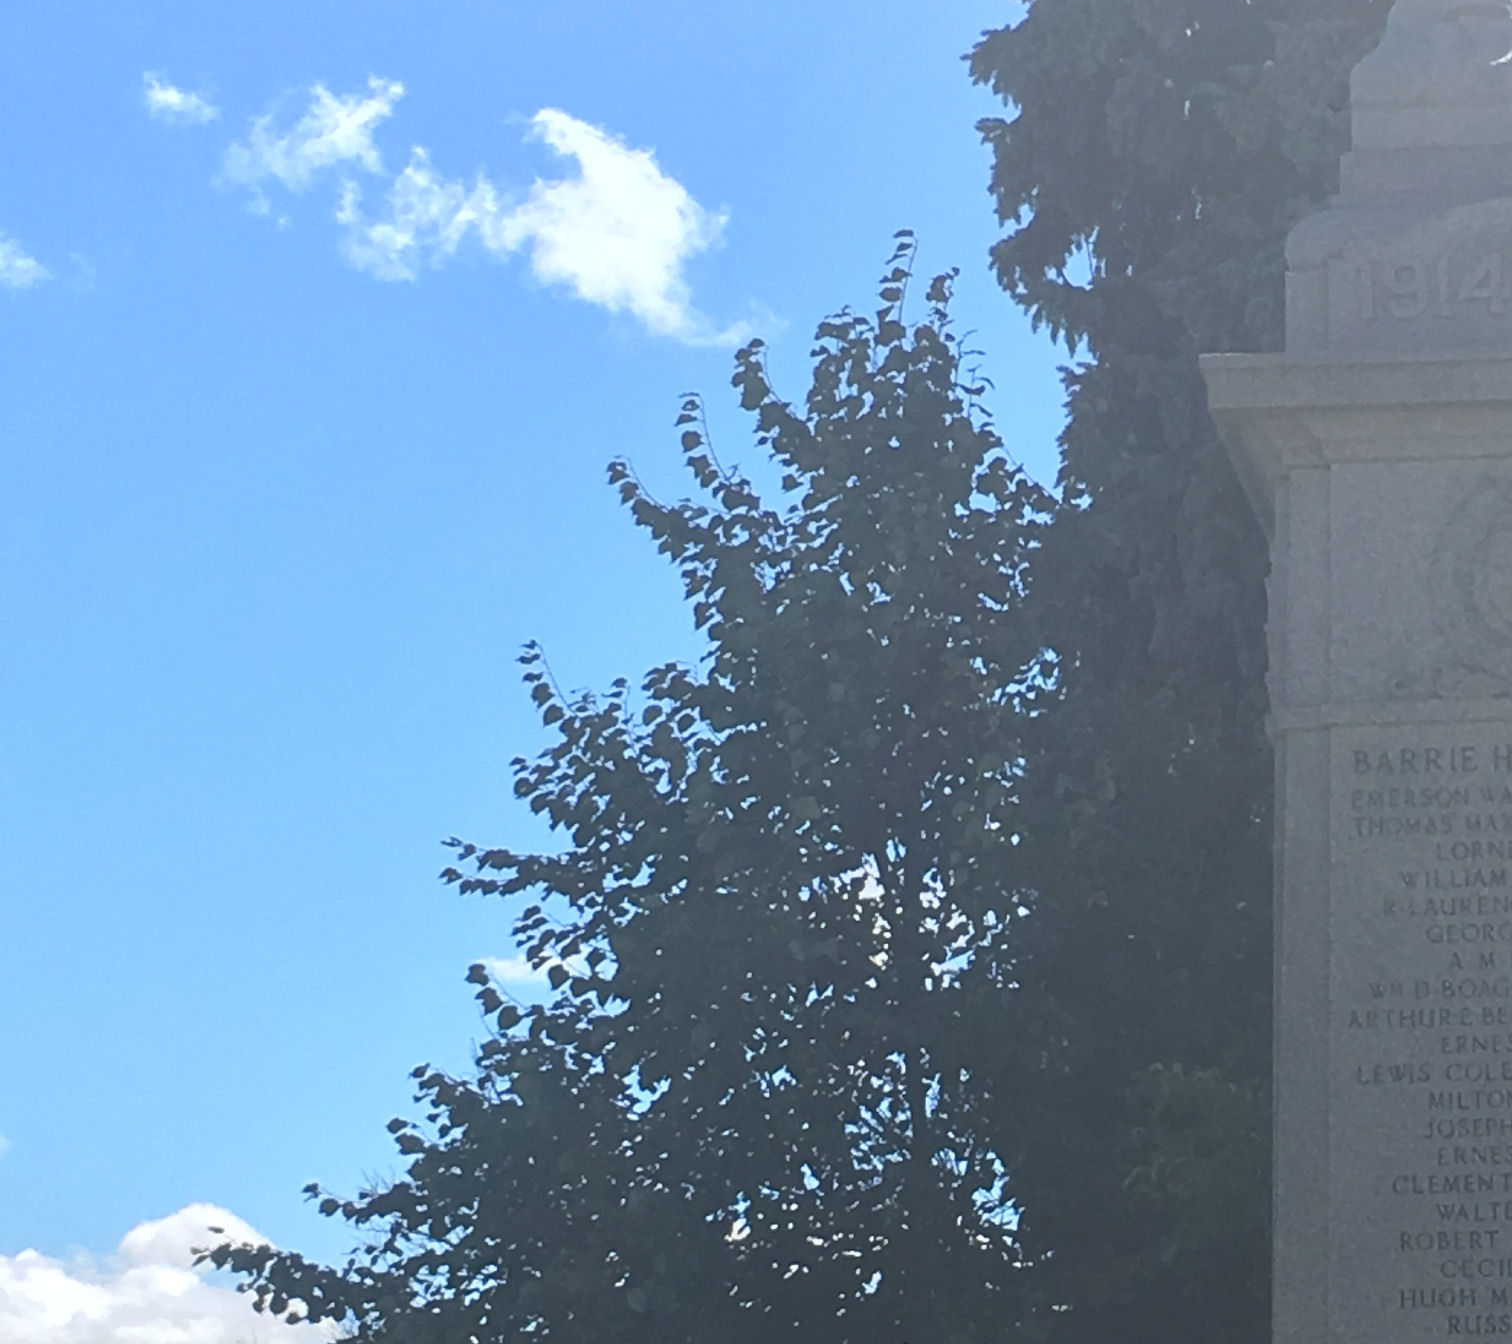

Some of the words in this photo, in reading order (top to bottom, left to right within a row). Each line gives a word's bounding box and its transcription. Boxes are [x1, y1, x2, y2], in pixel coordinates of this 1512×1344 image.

[1354, 254, 1510, 321] 1914
[1352, 745, 1478, 775] BARRIE
[1351, 789, 1470, 810] EMERSON
[1351, 815, 1453, 838] THOMAS
[1400, 868, 1507, 889] WILLIAM
[1442, 976, 1510, 997] BOAG
[1348, 1008, 1451, 1029] ARTHUR
[1356, 1062, 1431, 1085] LEWIS
[1392, 1172, 1512, 1194] CLEMENT
[1399, 1229, 1499, 1251] ROBERT
[1400, 1287, 1477, 1308] HUGH
